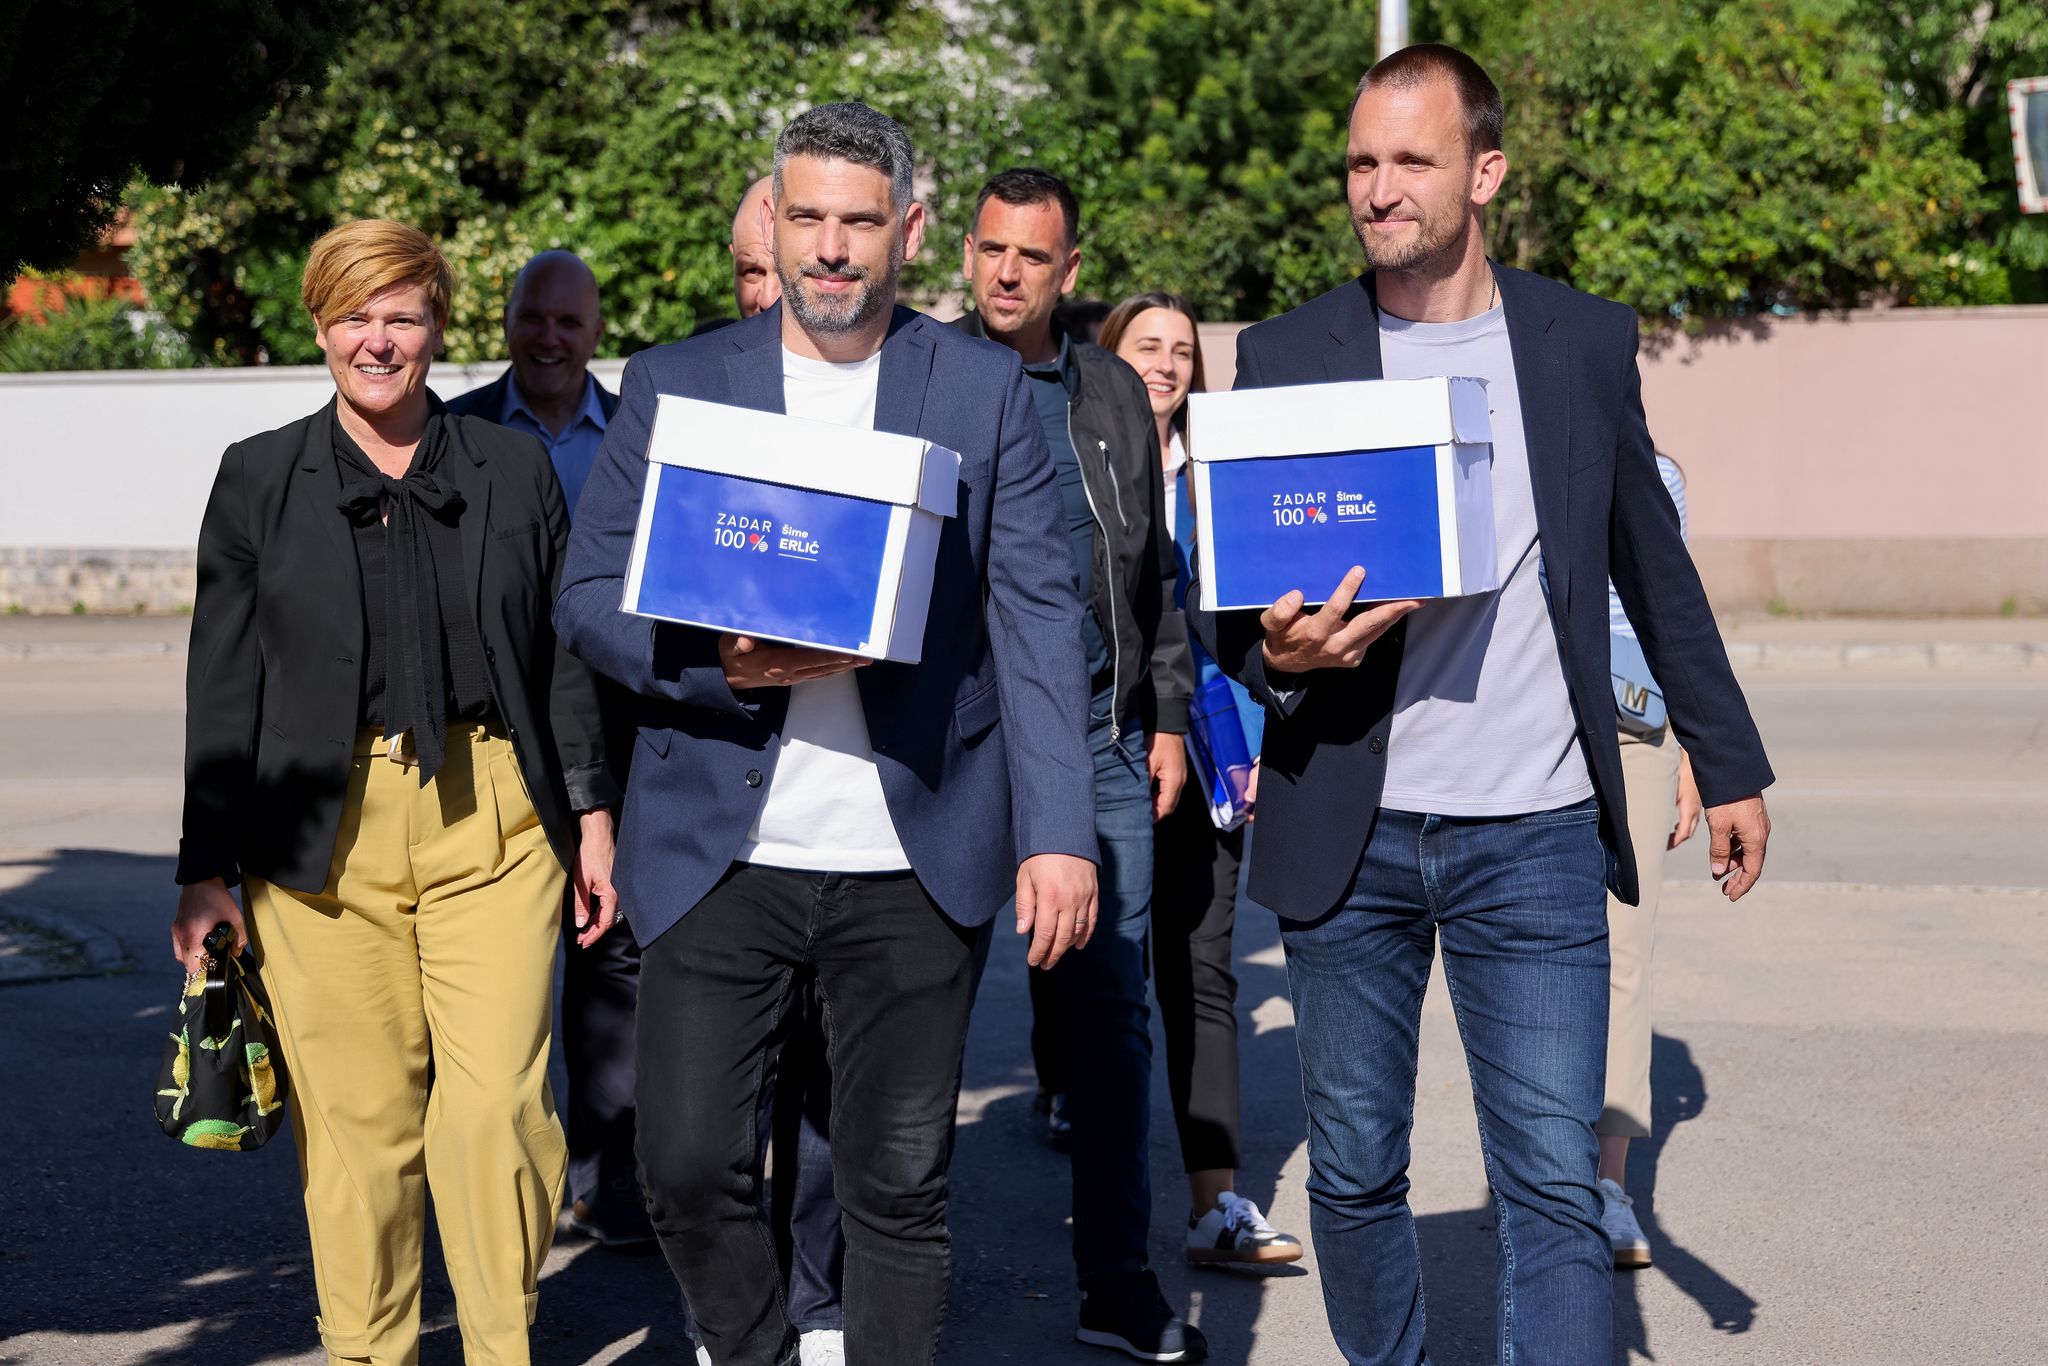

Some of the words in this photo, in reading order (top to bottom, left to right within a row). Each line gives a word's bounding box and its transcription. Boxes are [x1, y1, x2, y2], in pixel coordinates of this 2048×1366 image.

[1273, 492, 1326, 506] ZADAR
[1336, 491, 1362, 501] Šime
[1337, 501, 1376, 515] ERLIĆ
[717, 513, 772, 532] ZADAR
[782, 524, 808, 538] Šime
[779, 538, 819, 554] ERLIĆ
[1621, 681, 1648, 711] M
